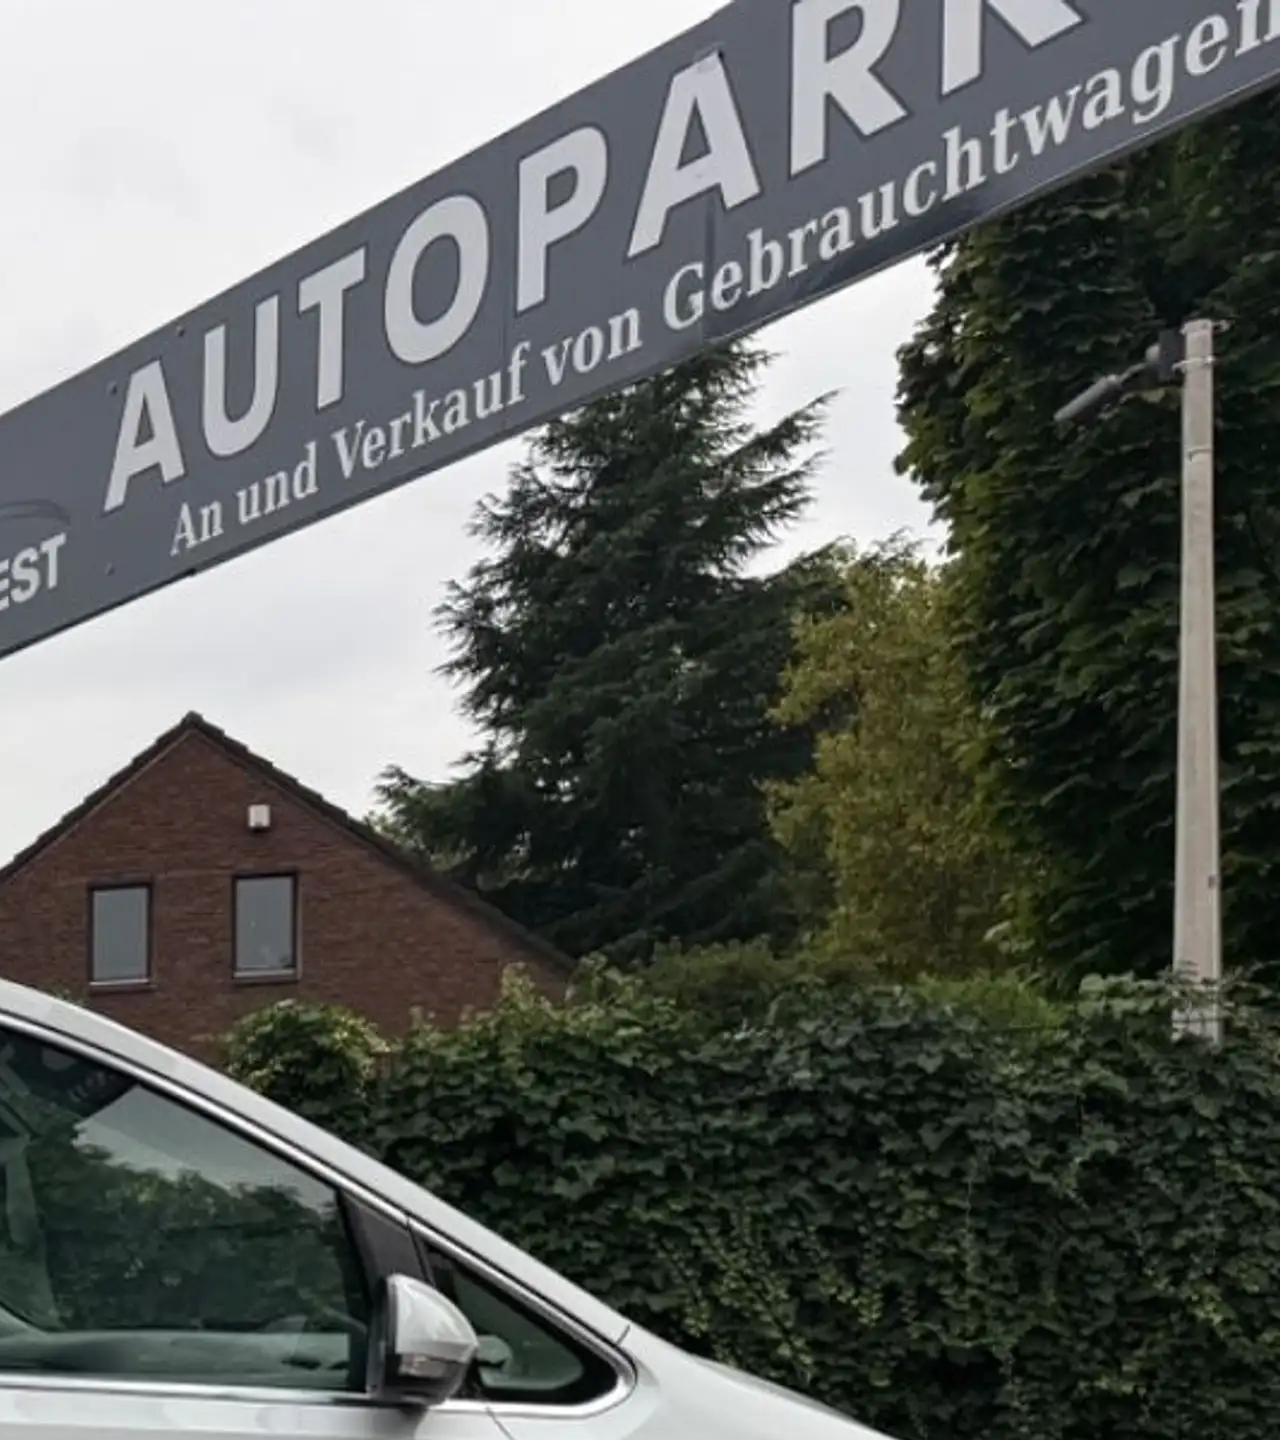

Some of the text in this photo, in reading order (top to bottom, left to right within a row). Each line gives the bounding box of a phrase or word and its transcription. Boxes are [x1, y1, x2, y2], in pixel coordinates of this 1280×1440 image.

[170, 501, 224, 557] An
[238, 442, 319, 525] und
[331, 341, 530, 480] Verkauf
[540, 306, 642, 386] von
